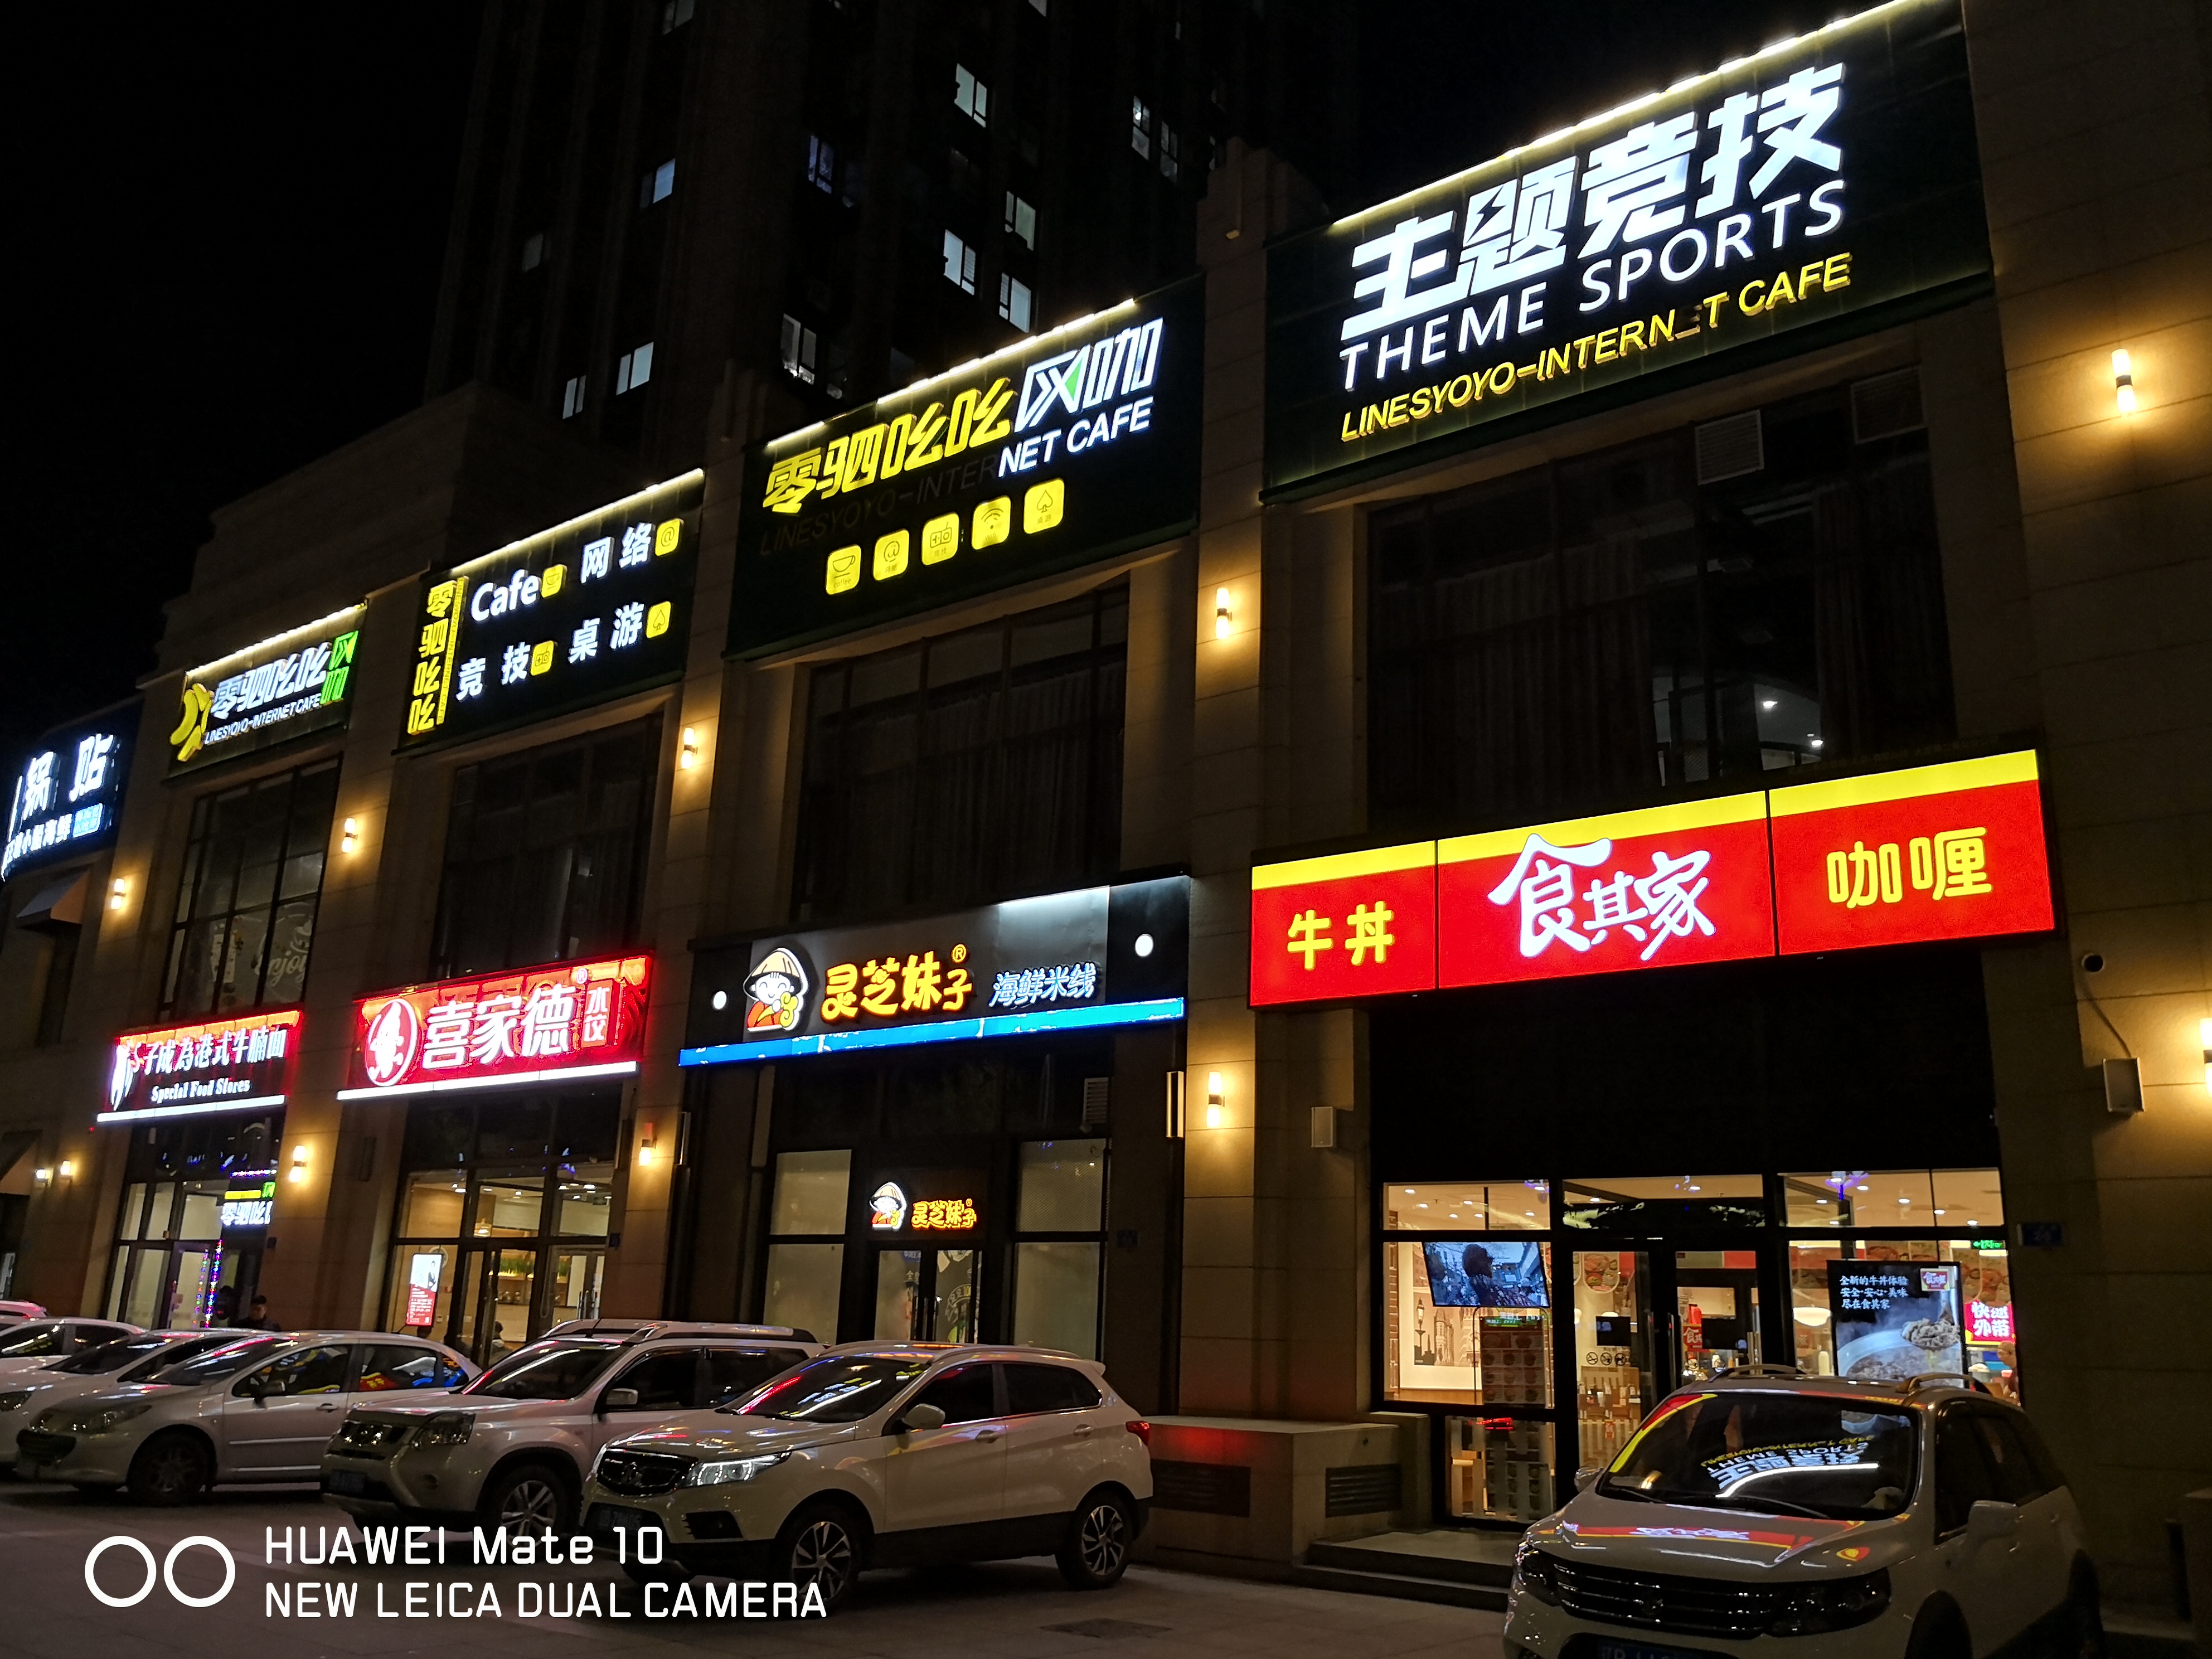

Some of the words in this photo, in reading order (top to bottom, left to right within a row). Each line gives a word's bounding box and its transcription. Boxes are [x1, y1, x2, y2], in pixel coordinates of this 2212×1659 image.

[1340, 61, 1845, 342] 主题竞技
[1339, 282, 1547, 392] THEME
[1579, 179, 1846, 312] SPORTS
[1738, 252, 1852, 316] CAFE
[1066, 397, 1156, 453] CAFE
[470, 569, 542, 622] Cafe
[580, 522, 656, 584] 网络
[833, 578, 852, 588] coffee
[455, 642, 531, 701] 竞技
[567, 601, 646, 664] 桌游
[295, 692, 322, 714] CAFE
[1487, 832, 1716, 961] 食其家
[1825, 826, 1993, 909] 咖喱
[1287, 901, 1395, 971] 牛丼
[584, 985, 611, 1042] 水饺
[820, 950, 974, 1023] 灵芝妹子
[988, 962, 1097, 1010] 海鲜米线
[421, 983, 576, 1070] 喜家德
[151, 1081, 188, 1104] Special
[190, 1079, 215, 1098] Food
[215, 1077, 250, 1095] Stores
[911, 1199, 977, 1229] 灵芝妹子
